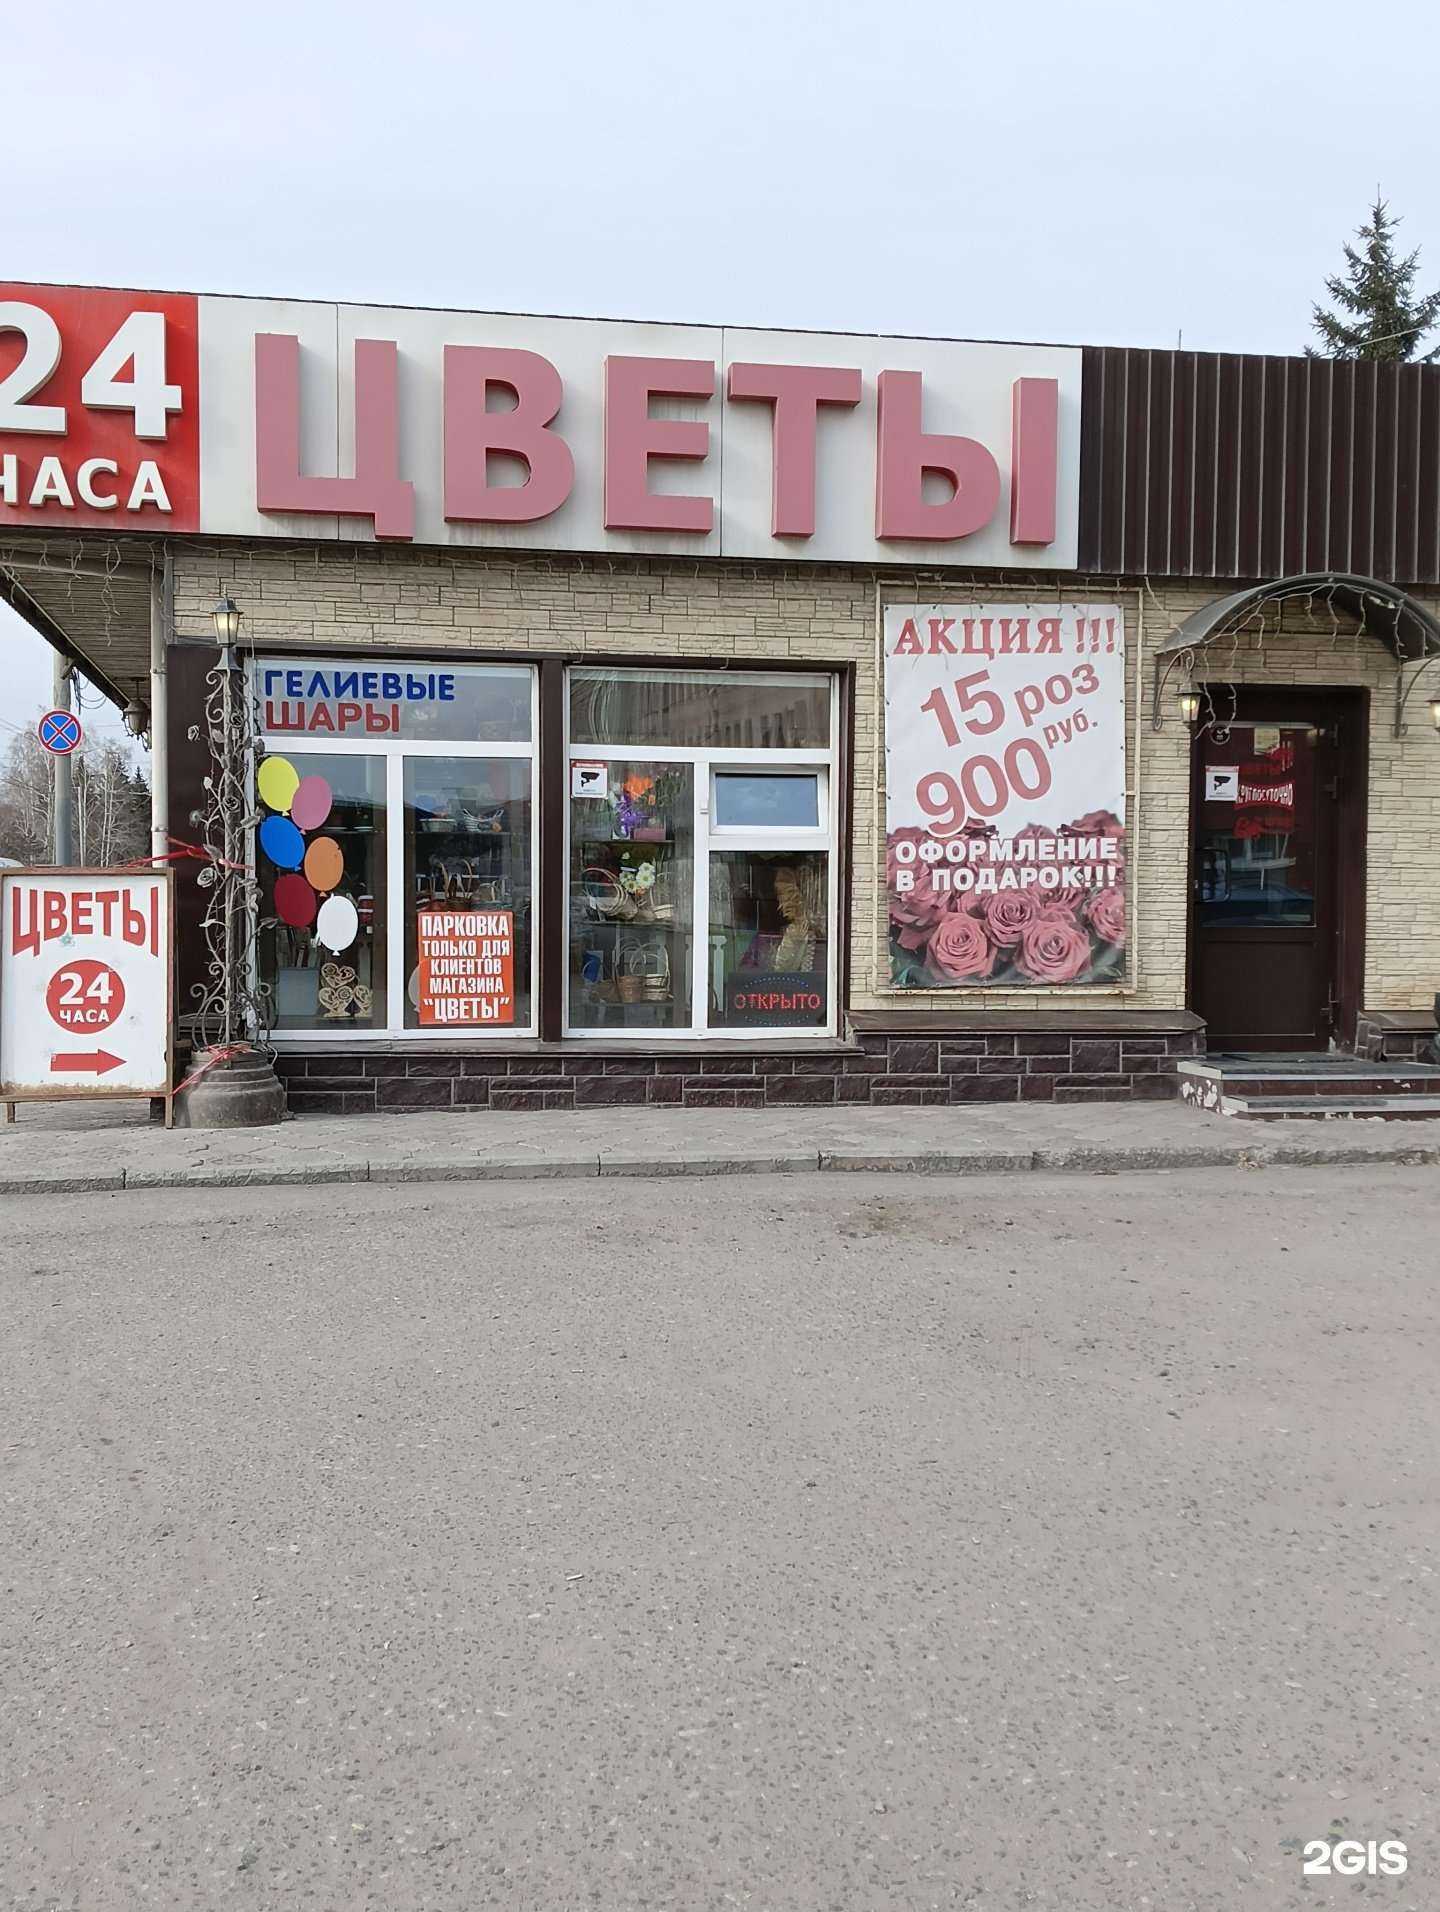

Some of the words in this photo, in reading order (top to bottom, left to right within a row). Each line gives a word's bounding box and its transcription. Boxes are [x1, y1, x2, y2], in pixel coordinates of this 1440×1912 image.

[0, 301, 182, 440] 24
[254, 332, 1059, 546] ЦВЕТЫ
[893, 618, 1063, 660] АКЦИЯ
[264, 670, 455, 701] ГЕЛИЕВЫЕ
[265, 700, 400, 733] ШАРЫ
[920, 668, 1006, 747] 15
[1014, 663, 1100, 727] роз
[915, 737, 1053, 839] 900
[1042, 707, 1099, 749] руб.
[895, 837, 1118, 863] ОФОРМЛЕНИЕ
[896, 870, 914, 892] В
[932, 866, 1116, 894] ПОДАРОК!!!
[12, 886, 159, 958] ЦВЕТЫ
[421, 915, 510, 937] ПАРКОВКА
[422, 940, 477, 957] ТОЛЬКО
[481, 940, 510, 959] ДЛЯ
[430, 958, 502, 976] КЛИЕНТОВ
[59, 971, 114, 1006] 24
[429, 977, 504, 994] МАГАЗИНА
[59, 1008, 110, 1023] ЧАСА
[734, 993, 821, 1010] ОТКРЫТО
